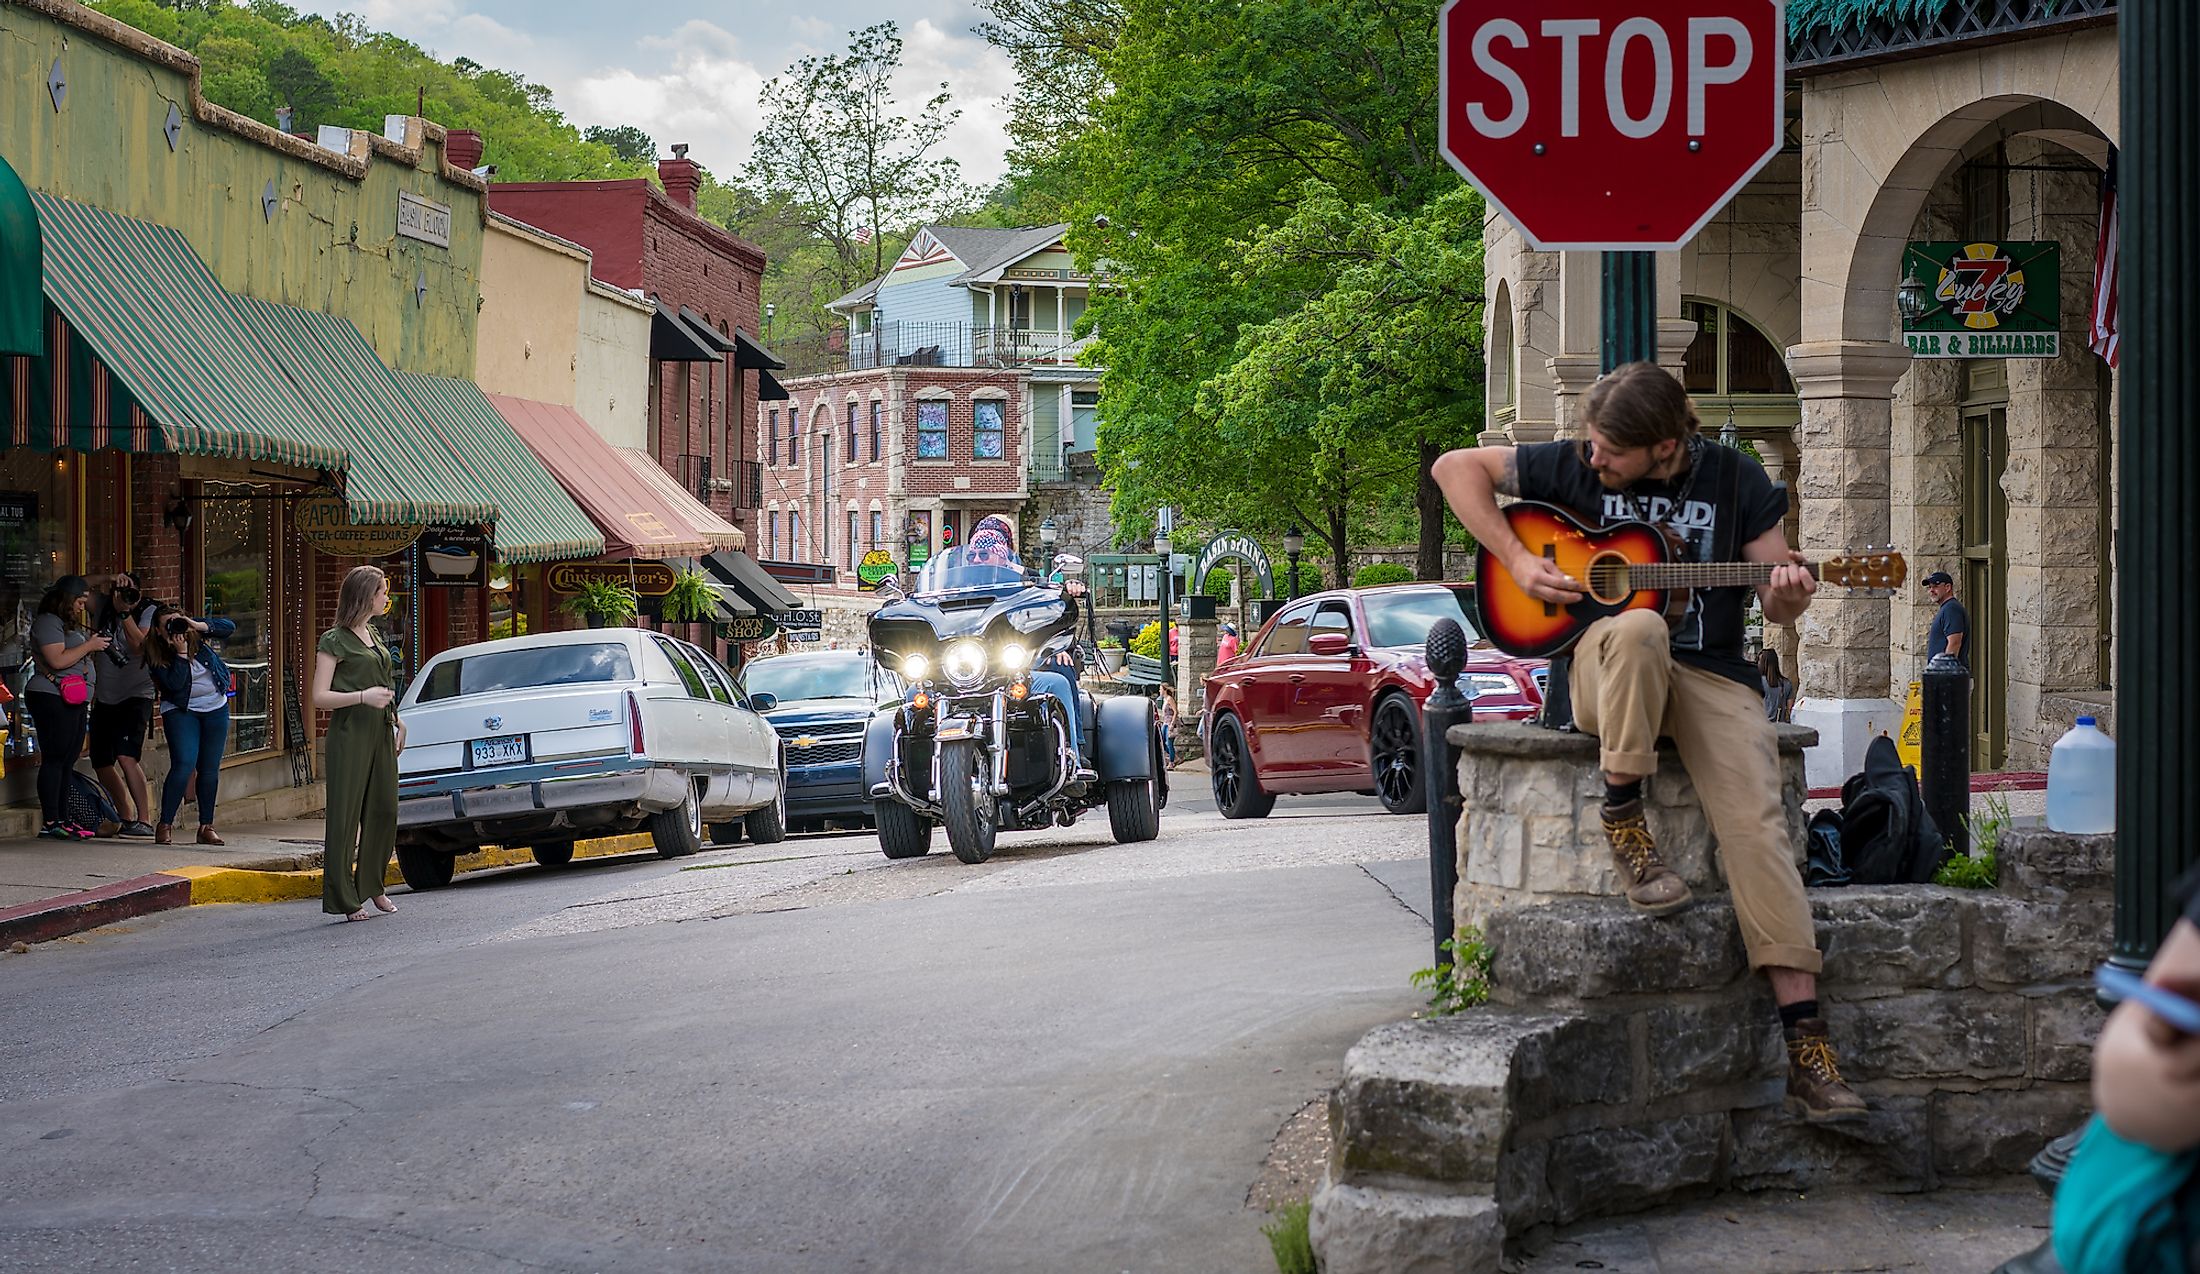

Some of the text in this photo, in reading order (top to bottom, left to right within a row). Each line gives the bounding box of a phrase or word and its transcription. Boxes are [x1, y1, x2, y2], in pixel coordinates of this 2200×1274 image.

[1466, 16, 1753, 139] STOP
[1935, 270, 2026, 314] Lucky
[1955, 259, 2009, 314] 7
[1907, 335, 2056, 355] BAR & BILLIARDS
[1649, 495, 1717, 529] DUD
[1200, 537, 1228, 576] BASIN
[555, 565, 668, 586] Christopher's
[727, 627, 763, 638] SHOP
[728, 618, 764, 629] TOWN
[475, 743, 523, 760] 933 XKX
